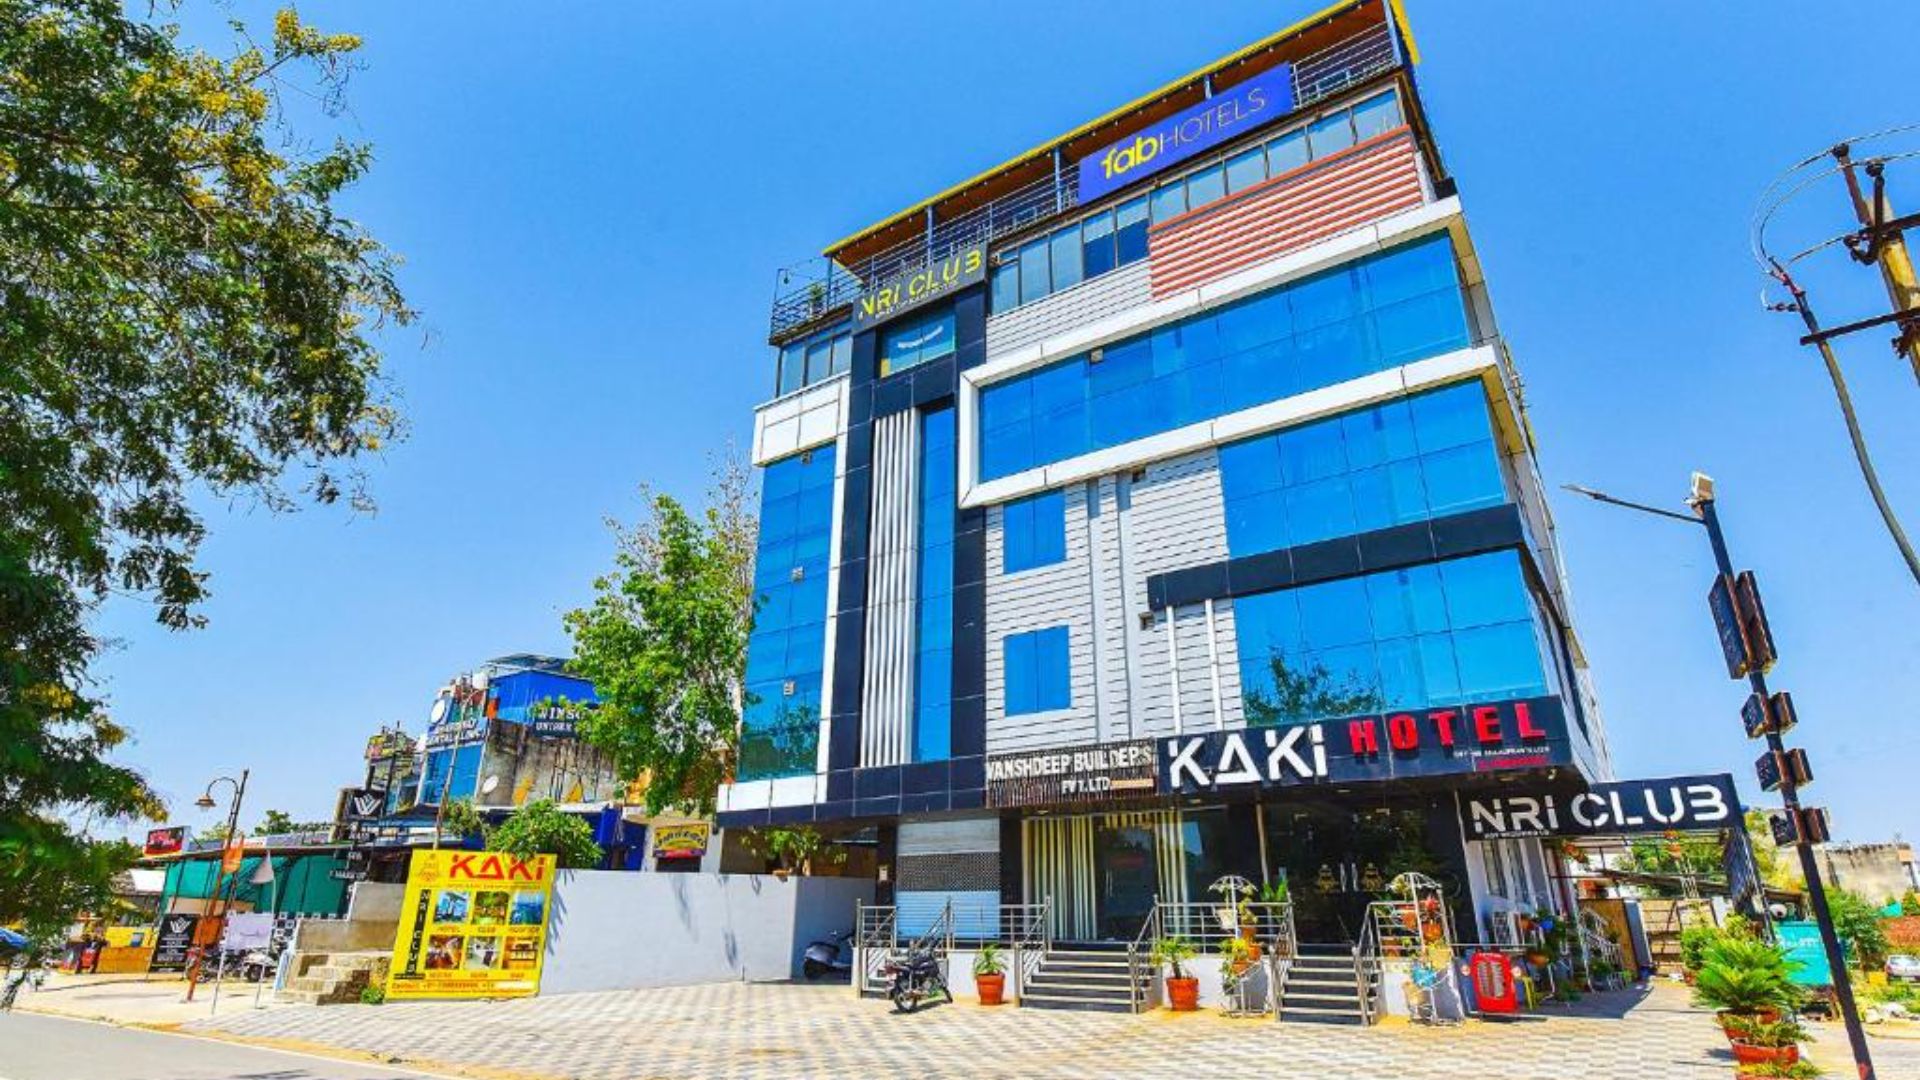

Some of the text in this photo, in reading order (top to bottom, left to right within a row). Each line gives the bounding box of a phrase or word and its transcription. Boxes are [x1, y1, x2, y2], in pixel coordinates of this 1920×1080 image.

[1102, 87, 1266, 179] fabHOTELS
[857, 284, 901, 322] NRI
[908, 248, 982, 298] CLUB
[1168, 723, 1329, 789] KAKI
[1350, 703, 1546, 753] HOTEL
[1470, 784, 1730, 834] NRI CLUB
[449, 852, 546, 881] KAKI
